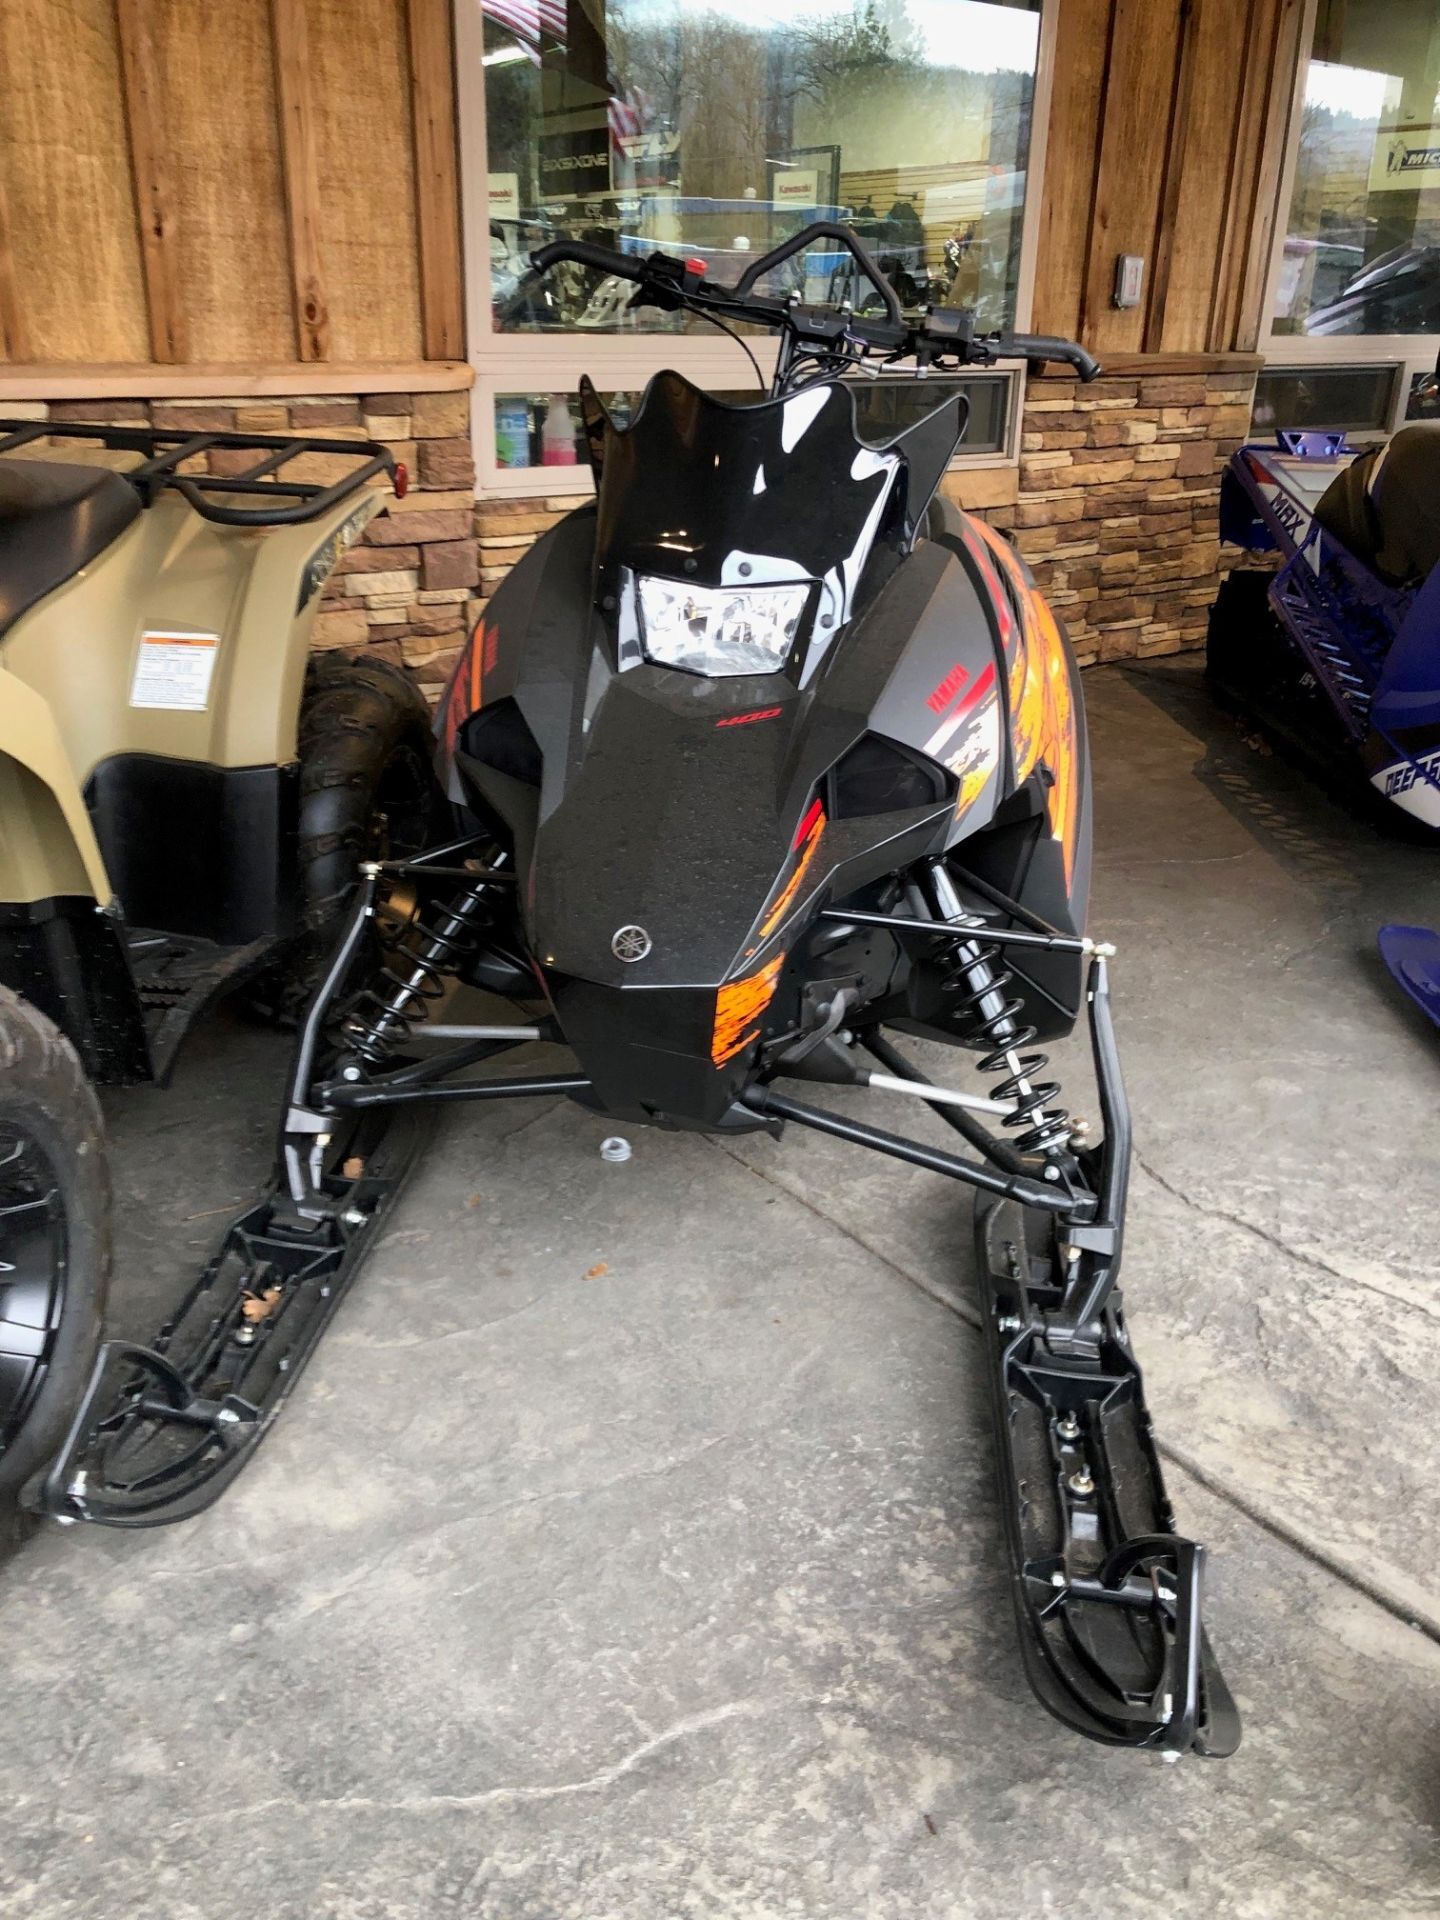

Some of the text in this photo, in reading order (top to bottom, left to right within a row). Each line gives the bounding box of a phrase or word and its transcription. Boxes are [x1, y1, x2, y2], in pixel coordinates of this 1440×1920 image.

[1270, 489, 1305, 540] MAX
[926, 663, 970, 716] YAMAHA
[715, 707, 783, 727] 400
